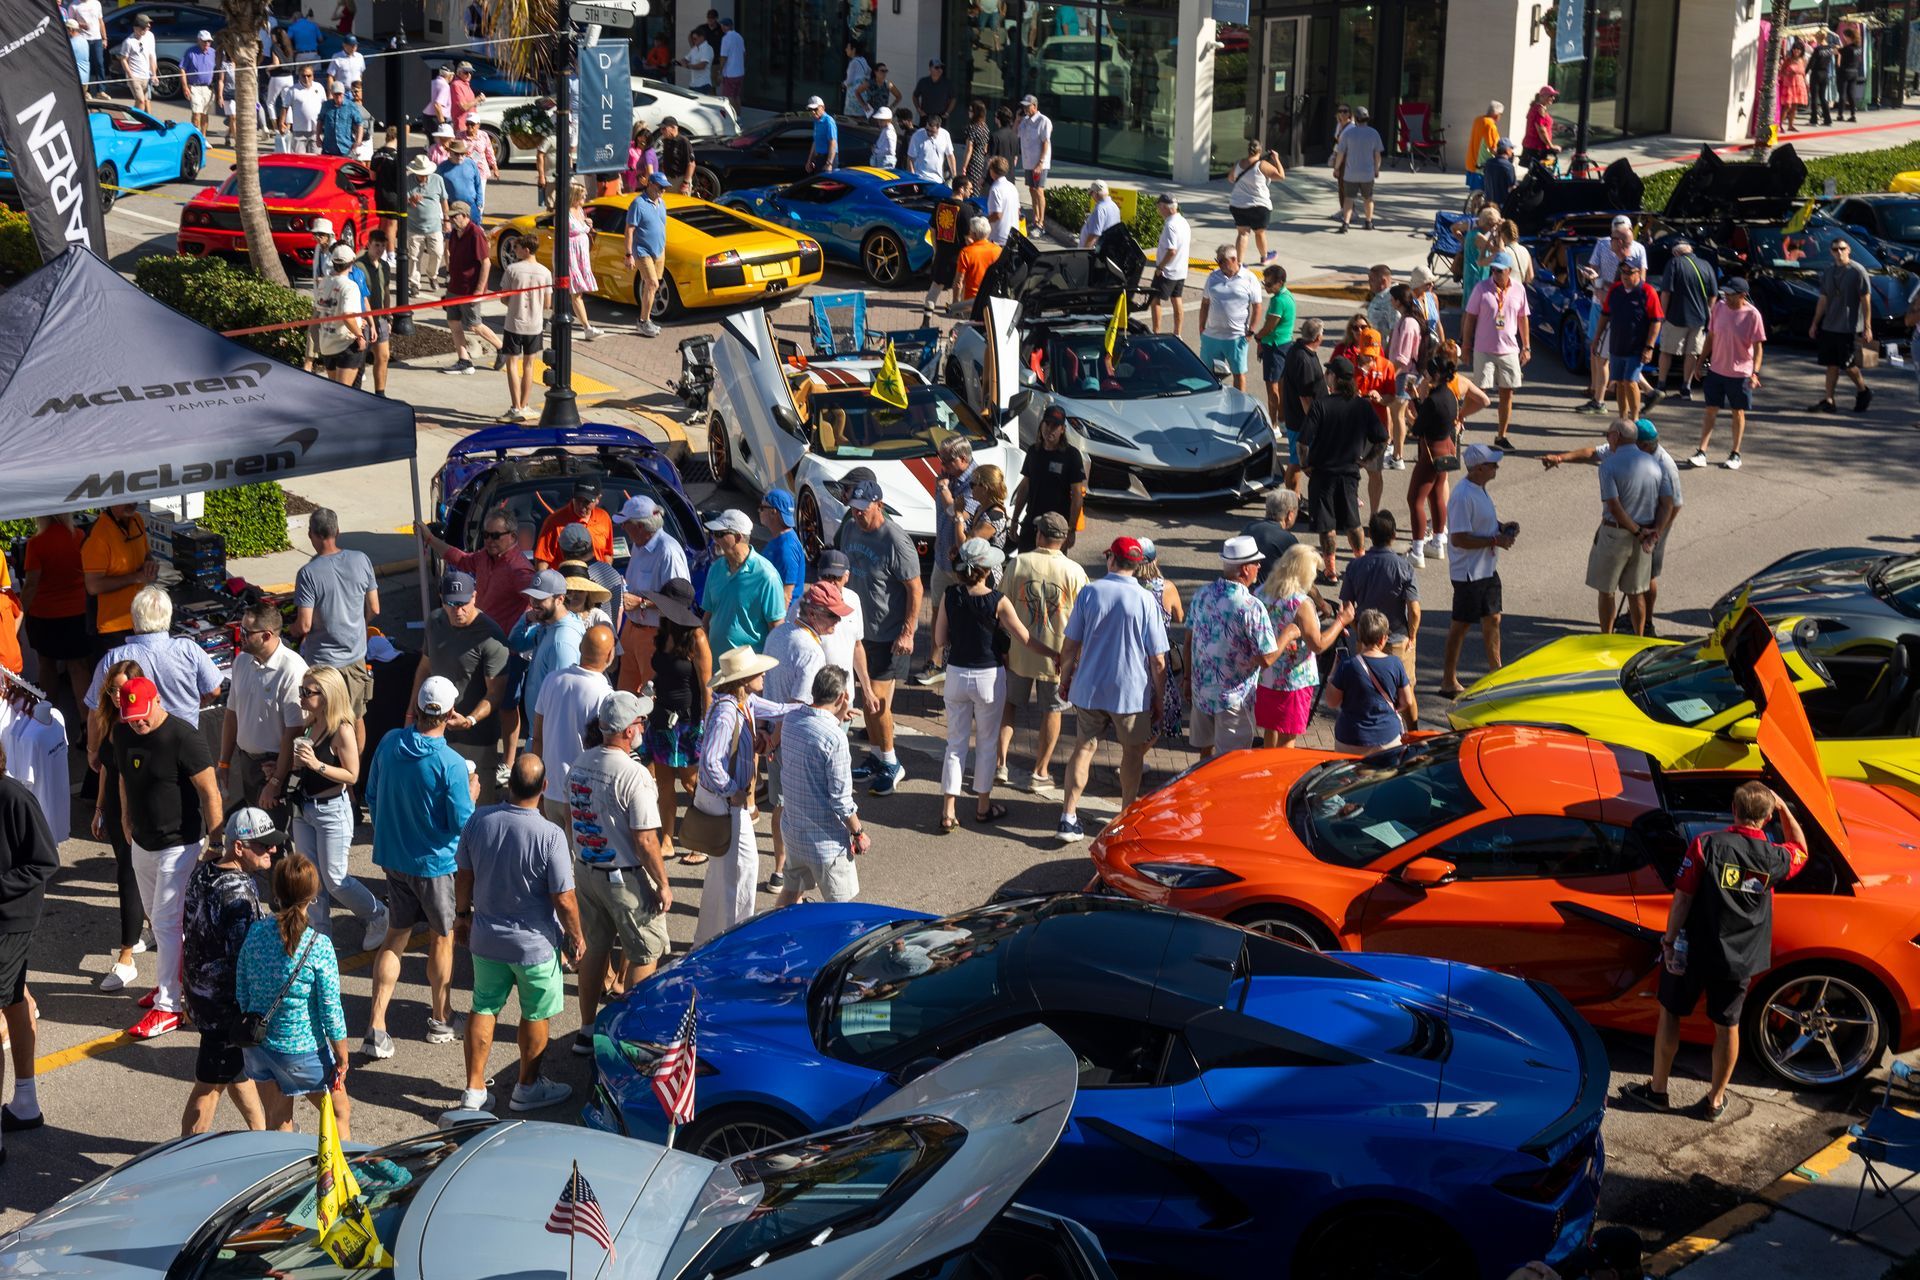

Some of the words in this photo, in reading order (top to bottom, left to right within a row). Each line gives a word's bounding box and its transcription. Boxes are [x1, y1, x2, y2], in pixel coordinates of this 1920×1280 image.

[585, 8, 600, 21] 5TH
[611, 12, 617, 24] S
[1565, 0, 1574, 30] AY
[599, 53, 613, 130] DINE
[31, 374, 258, 418] McLaren
[167, 398, 229, 413] TAMPA
[233, 393, 267, 406] BAY
[63, 449, 296, 502] McLaren
